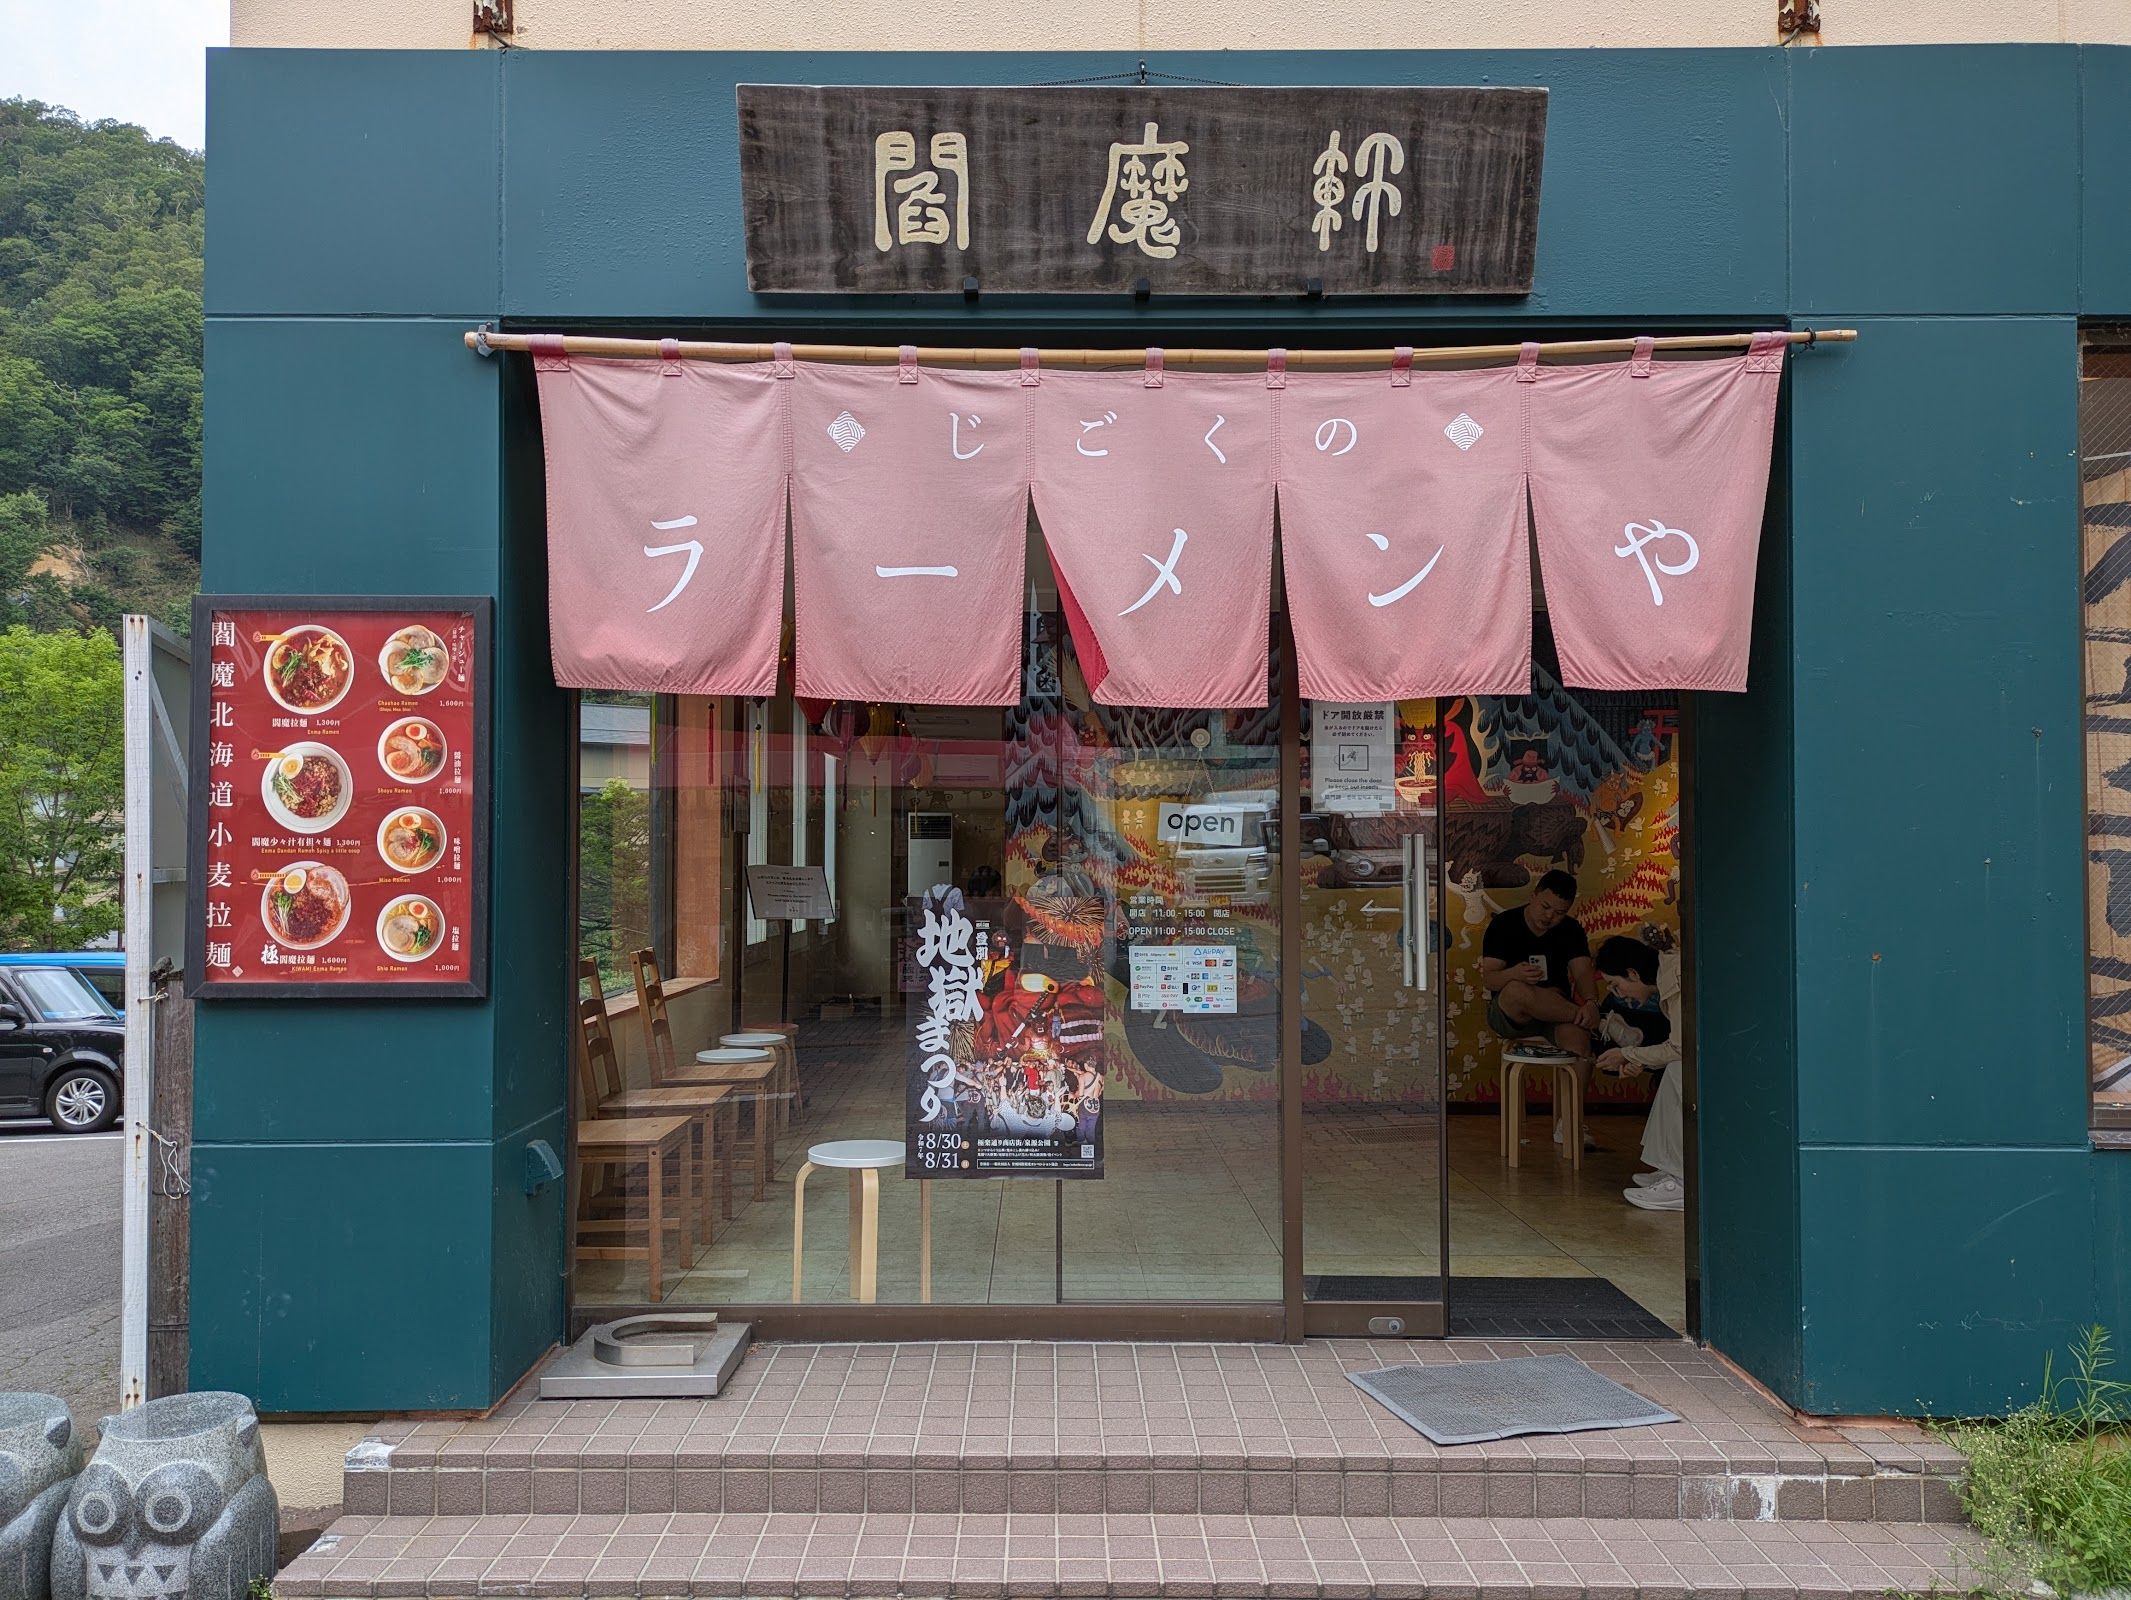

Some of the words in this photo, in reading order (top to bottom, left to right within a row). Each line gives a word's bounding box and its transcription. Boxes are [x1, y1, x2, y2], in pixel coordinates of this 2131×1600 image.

[949, 411, 1358, 464] じごくの
[643, 515, 1700, 616] ラーメンや
[1322, 710, 1385, 721] ドア開放厳禁
[1167, 813, 1235, 837] open
[1129, 895, 1164, 905] 営業時間
[1129, 908, 1146, 918] 開店
[1154, 909, 1176, 918] 11:00
[1184, 909, 1206, 918] 15:00
[1213, 909, 1230, 918] 閉店
[1128, 927, 1152, 936] OPEN
[1154, 927, 1176, 936] 11:00
[1184, 927, 1206, 936] 15:00
[1207, 927, 1235, 936] CLOSE
[975, 931, 989, 961] 登別
[916, 908, 984, 1122] 地獄まつり
[917, 1133, 925, 1160] 令和7年
[926, 1132, 961, 1149] 8/30
[925, 1151, 960, 1169] 8/31
